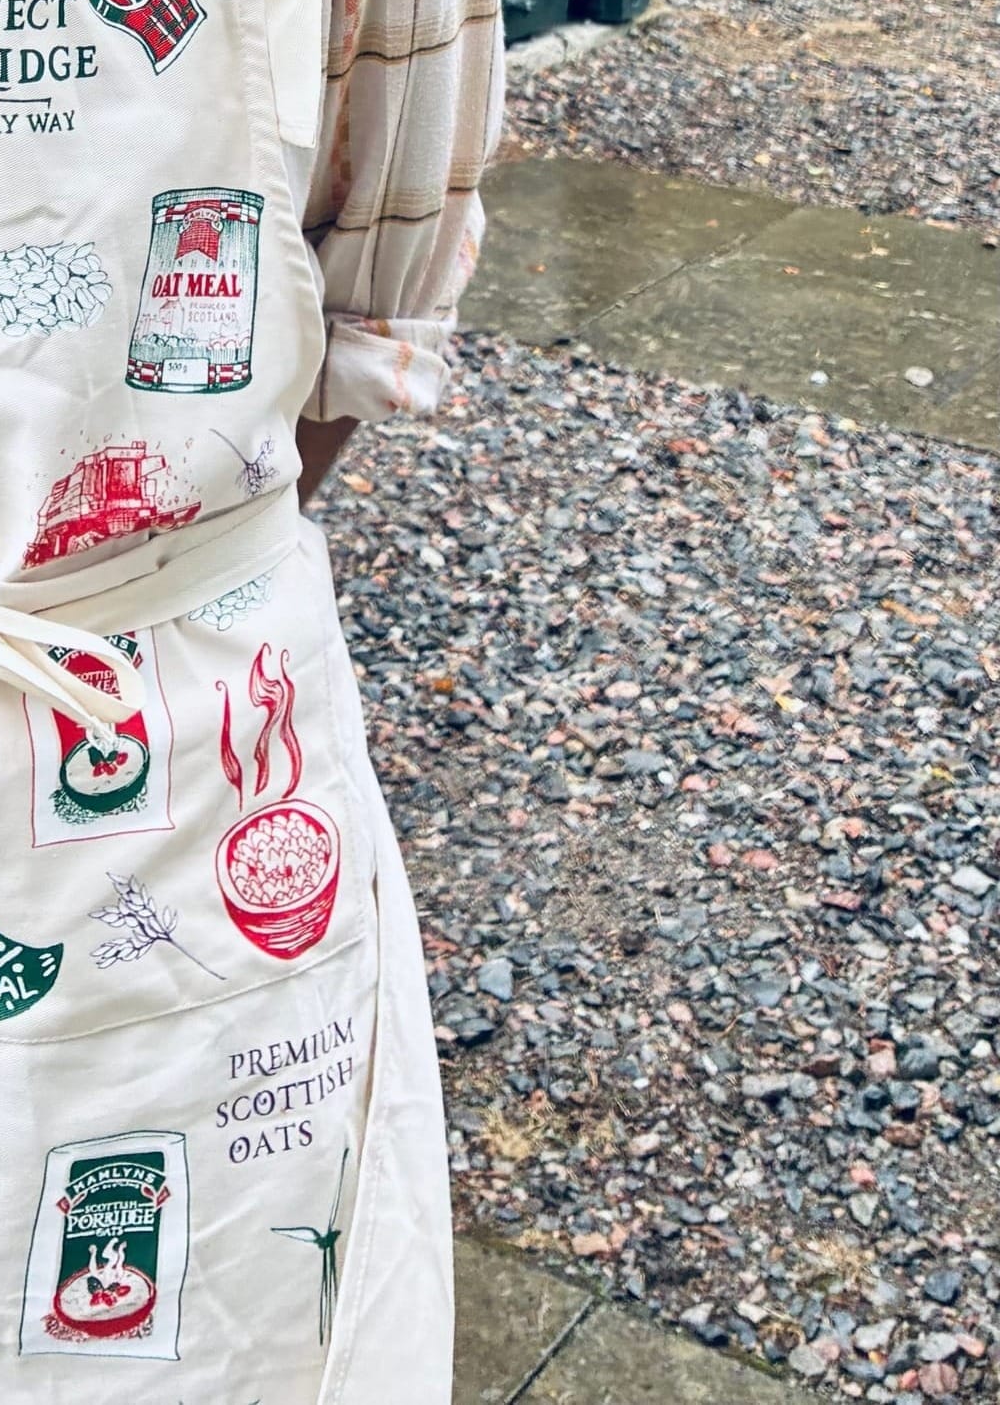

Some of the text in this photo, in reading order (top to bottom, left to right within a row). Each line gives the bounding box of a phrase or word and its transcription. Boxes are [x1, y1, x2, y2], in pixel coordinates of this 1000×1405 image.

[26, 109, 76, 134] WAY
[152, 273, 242, 298] OAT MEAL
[188, 310, 237, 323] SCOTLAND
[229, 1017, 355, 1080] PREMIUM
[216, 1057, 354, 1129] SCOTTISH
[229, 1120, 313, 1164] OATS
[73, 1167, 157, 1193] HAMLYNS
[67, 1208, 155, 1232] PORRIDGE
[85, 1201, 138, 1214] SCOTTISH
[96, 1226, 124, 1237] OATS
